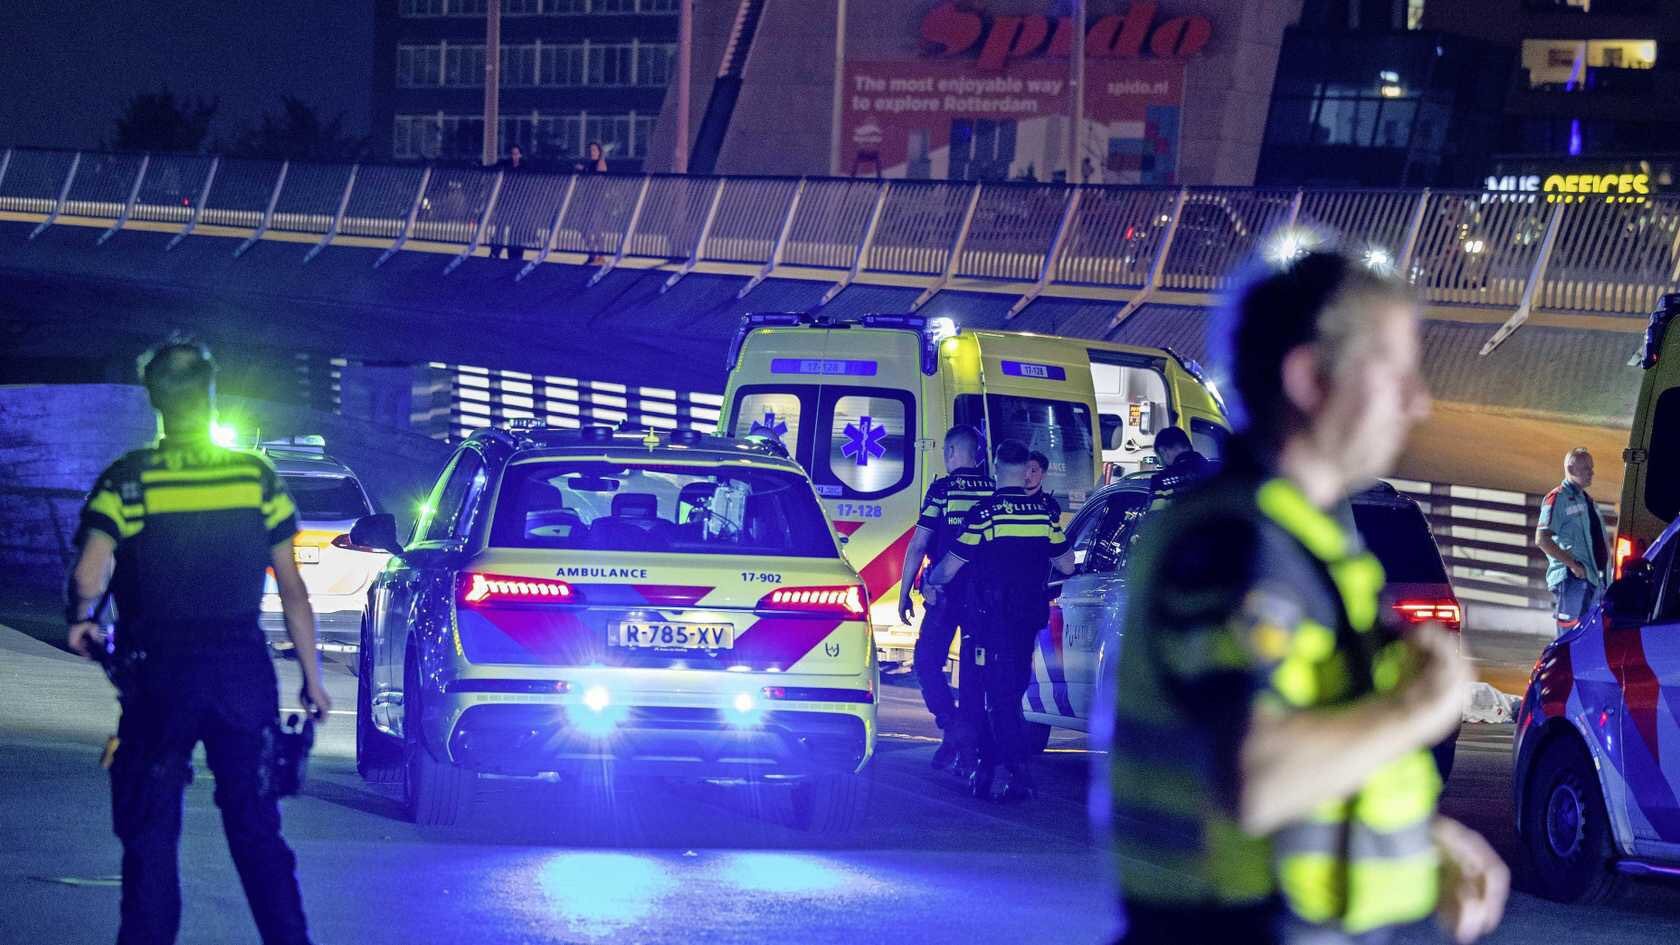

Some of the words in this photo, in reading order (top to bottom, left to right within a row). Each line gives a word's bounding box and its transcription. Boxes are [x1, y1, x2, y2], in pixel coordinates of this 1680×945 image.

[920, 1, 1212, 71] Spido
[855, 75, 886, 91] The
[889, 76, 934, 92] most
[938, 76, 1022, 95] enjoyable
[1027, 80, 1063, 95] way
[1107, 79, 1168, 96] spido.nl
[852, 95, 870, 111] to
[874, 96, 940, 113] explore
[943, 96, 1037, 112] Rotterdam
[1544, 174, 1649, 204] OFFICES
[837, 503, 882, 518] 17-128
[556, 567, 648, 579] AMBULANCE
[741, 572, 782, 584] 17-902
[626, 624, 724, 646] R-785-XV
